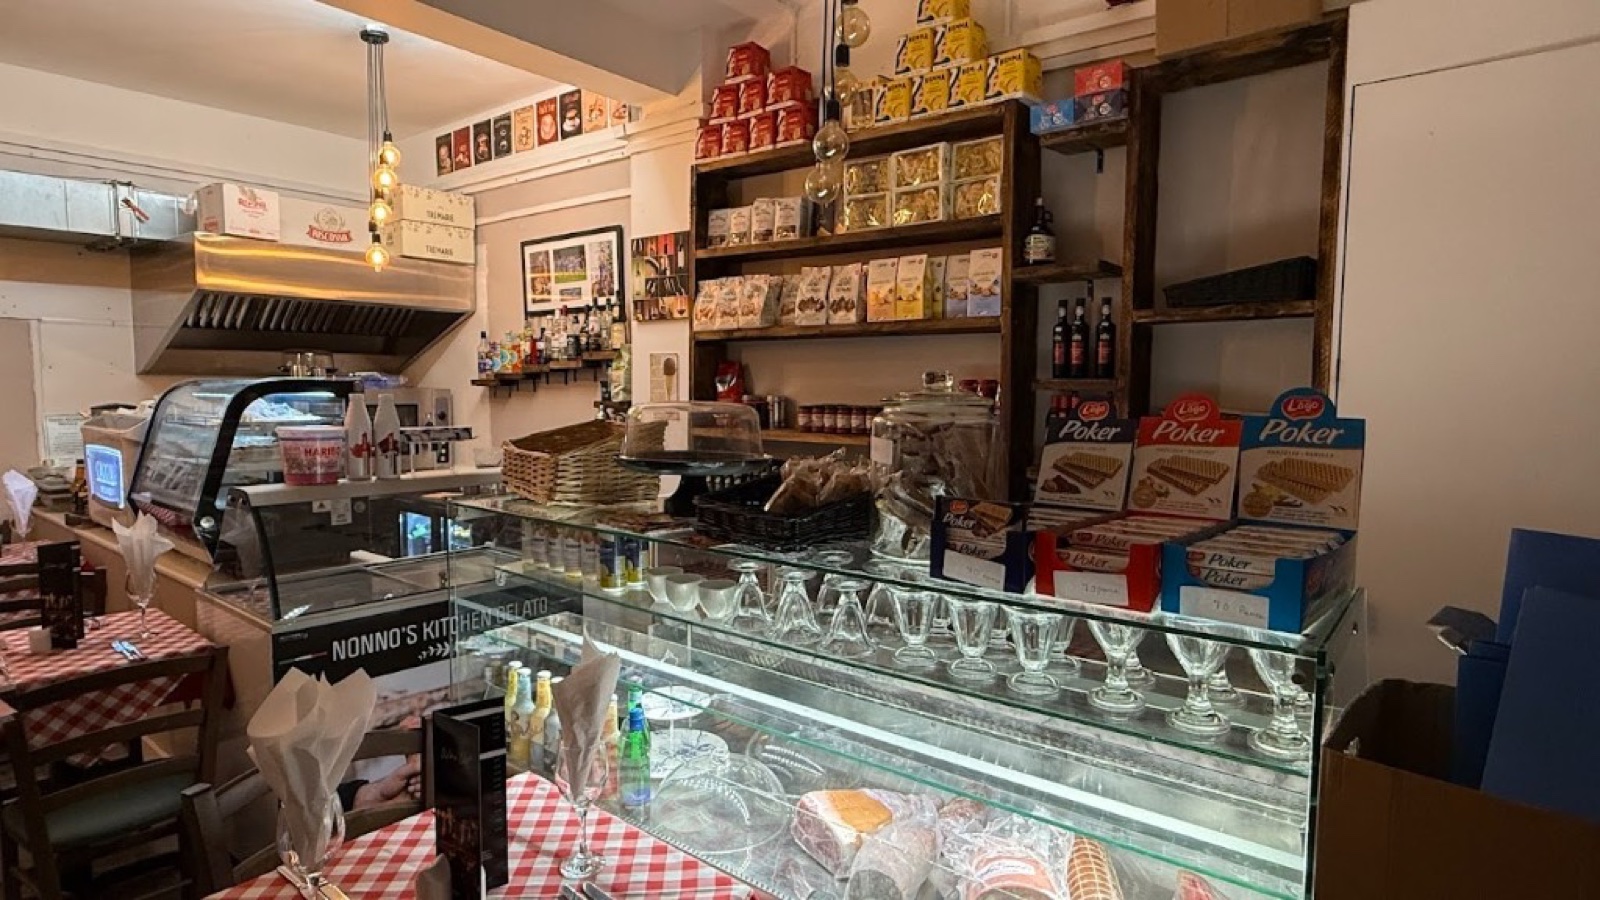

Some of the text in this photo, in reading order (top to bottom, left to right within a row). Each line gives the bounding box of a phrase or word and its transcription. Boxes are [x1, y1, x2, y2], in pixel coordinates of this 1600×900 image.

[1059, 420, 1122, 441] Poker
[1152, 420, 1225, 443] Poker
[1259, 419, 1346, 444] Poker
[942, 512, 976, 530] Poker
[1094, 533, 1130, 548] Poker
[1072, 552, 1110, 568] Poker
[1208, 552, 1252, 569] Poker
[1204, 568, 1248, 585] Poker
[332, 596, 548, 662] NONNO'S KITCHEN GELATO
